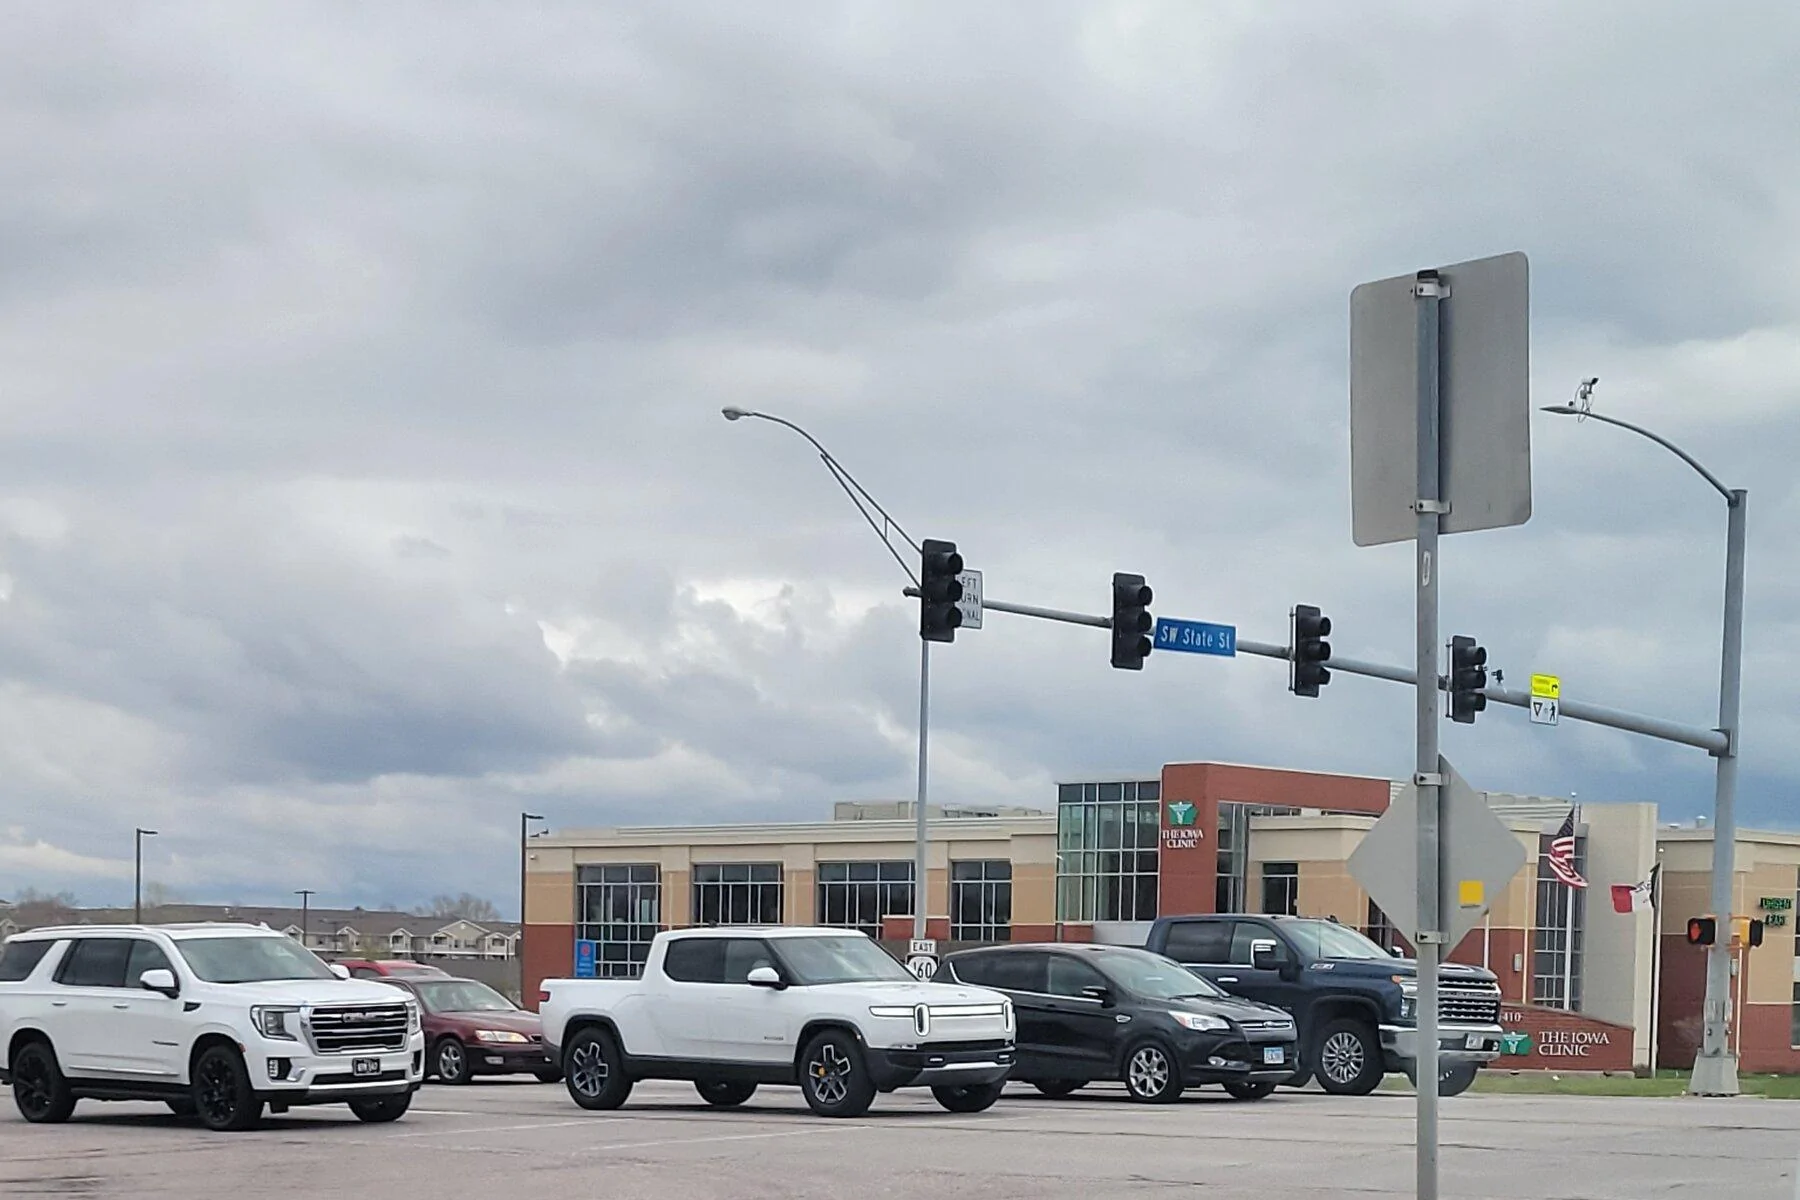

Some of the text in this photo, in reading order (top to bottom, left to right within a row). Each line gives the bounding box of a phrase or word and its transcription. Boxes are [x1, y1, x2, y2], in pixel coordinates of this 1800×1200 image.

[1161, 625, 1231, 651] SW State St
[1162, 829, 1204, 840] THE IOWA
[1166, 839, 1198, 849] CLINIC
[913, 942, 933, 952] EAST
[1539, 1031, 1610, 1045] THE IOWA
[1538, 1044, 1592, 1056] CLINIC
